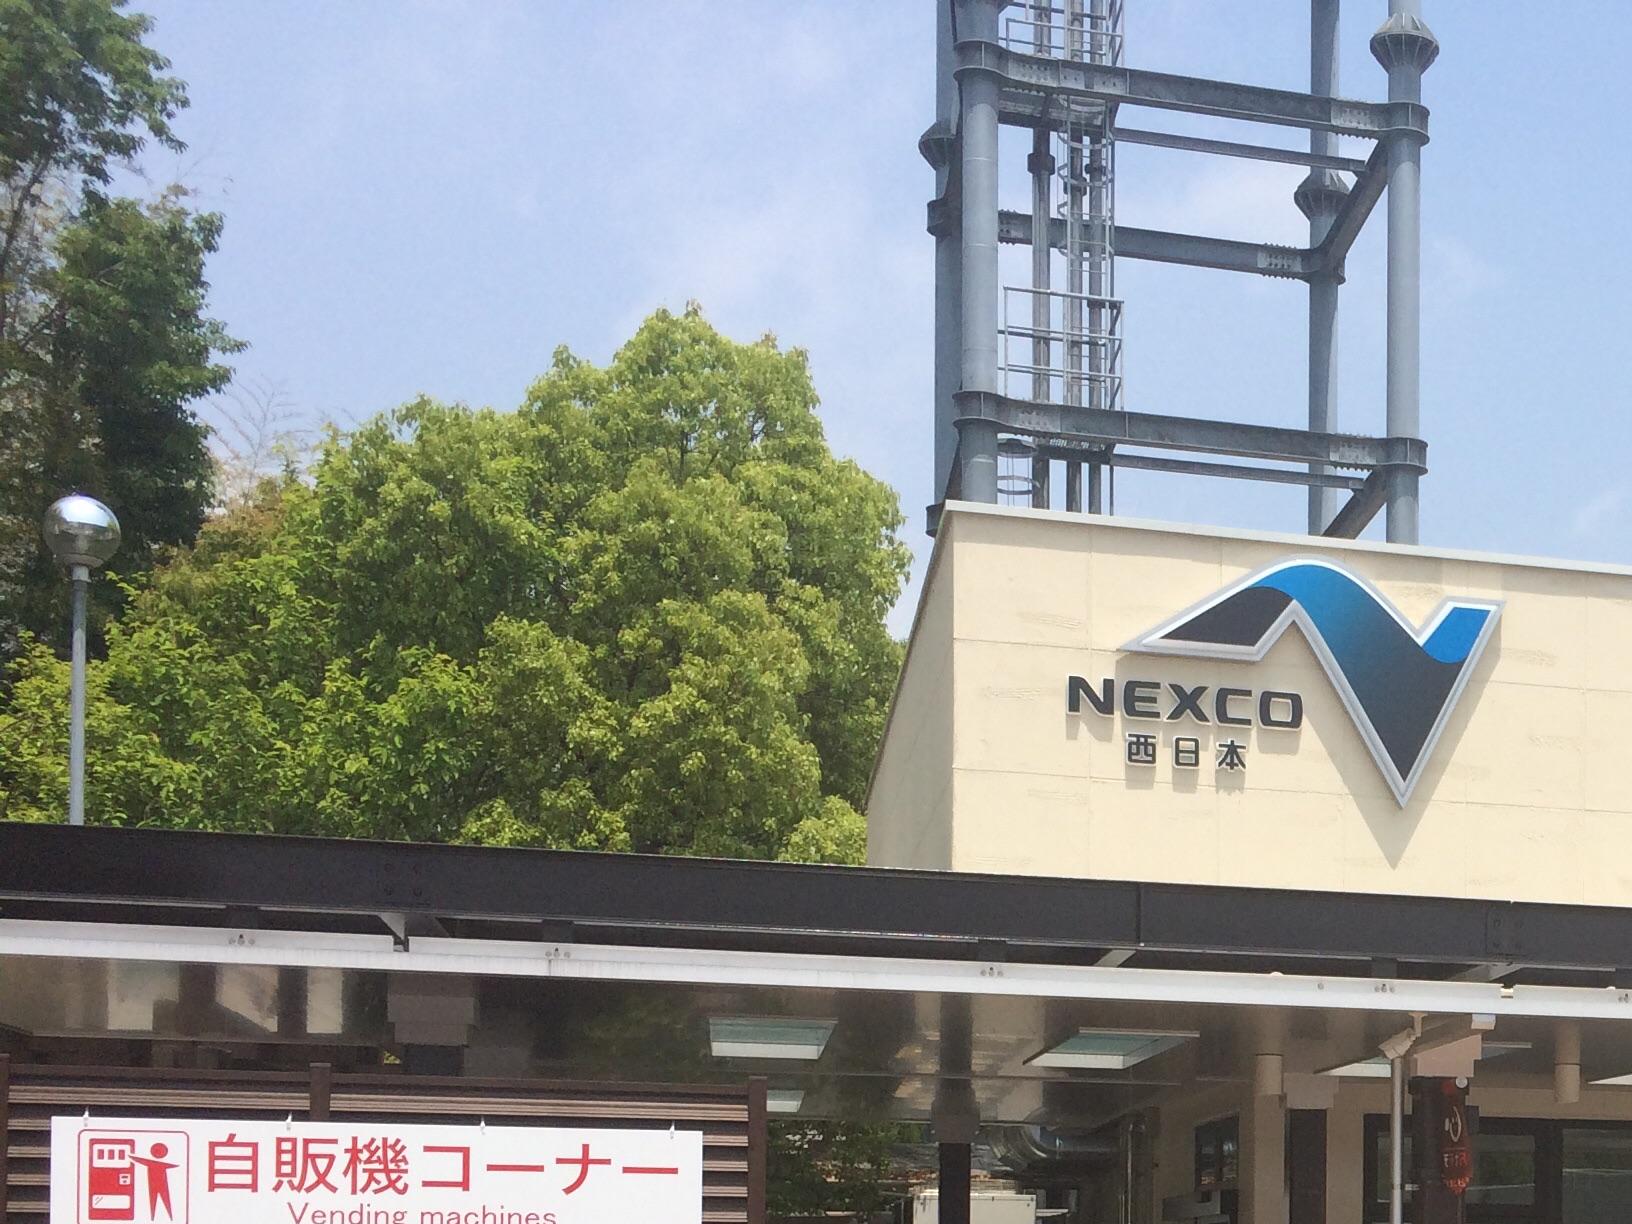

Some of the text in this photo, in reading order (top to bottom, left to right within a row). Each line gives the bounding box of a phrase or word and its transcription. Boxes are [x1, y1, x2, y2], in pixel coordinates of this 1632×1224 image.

[1067, 675, 1303, 729] NEXCO
[1126, 732, 1247, 771] 西日本
[206, 1132, 679, 1196] 自販機コーナー
